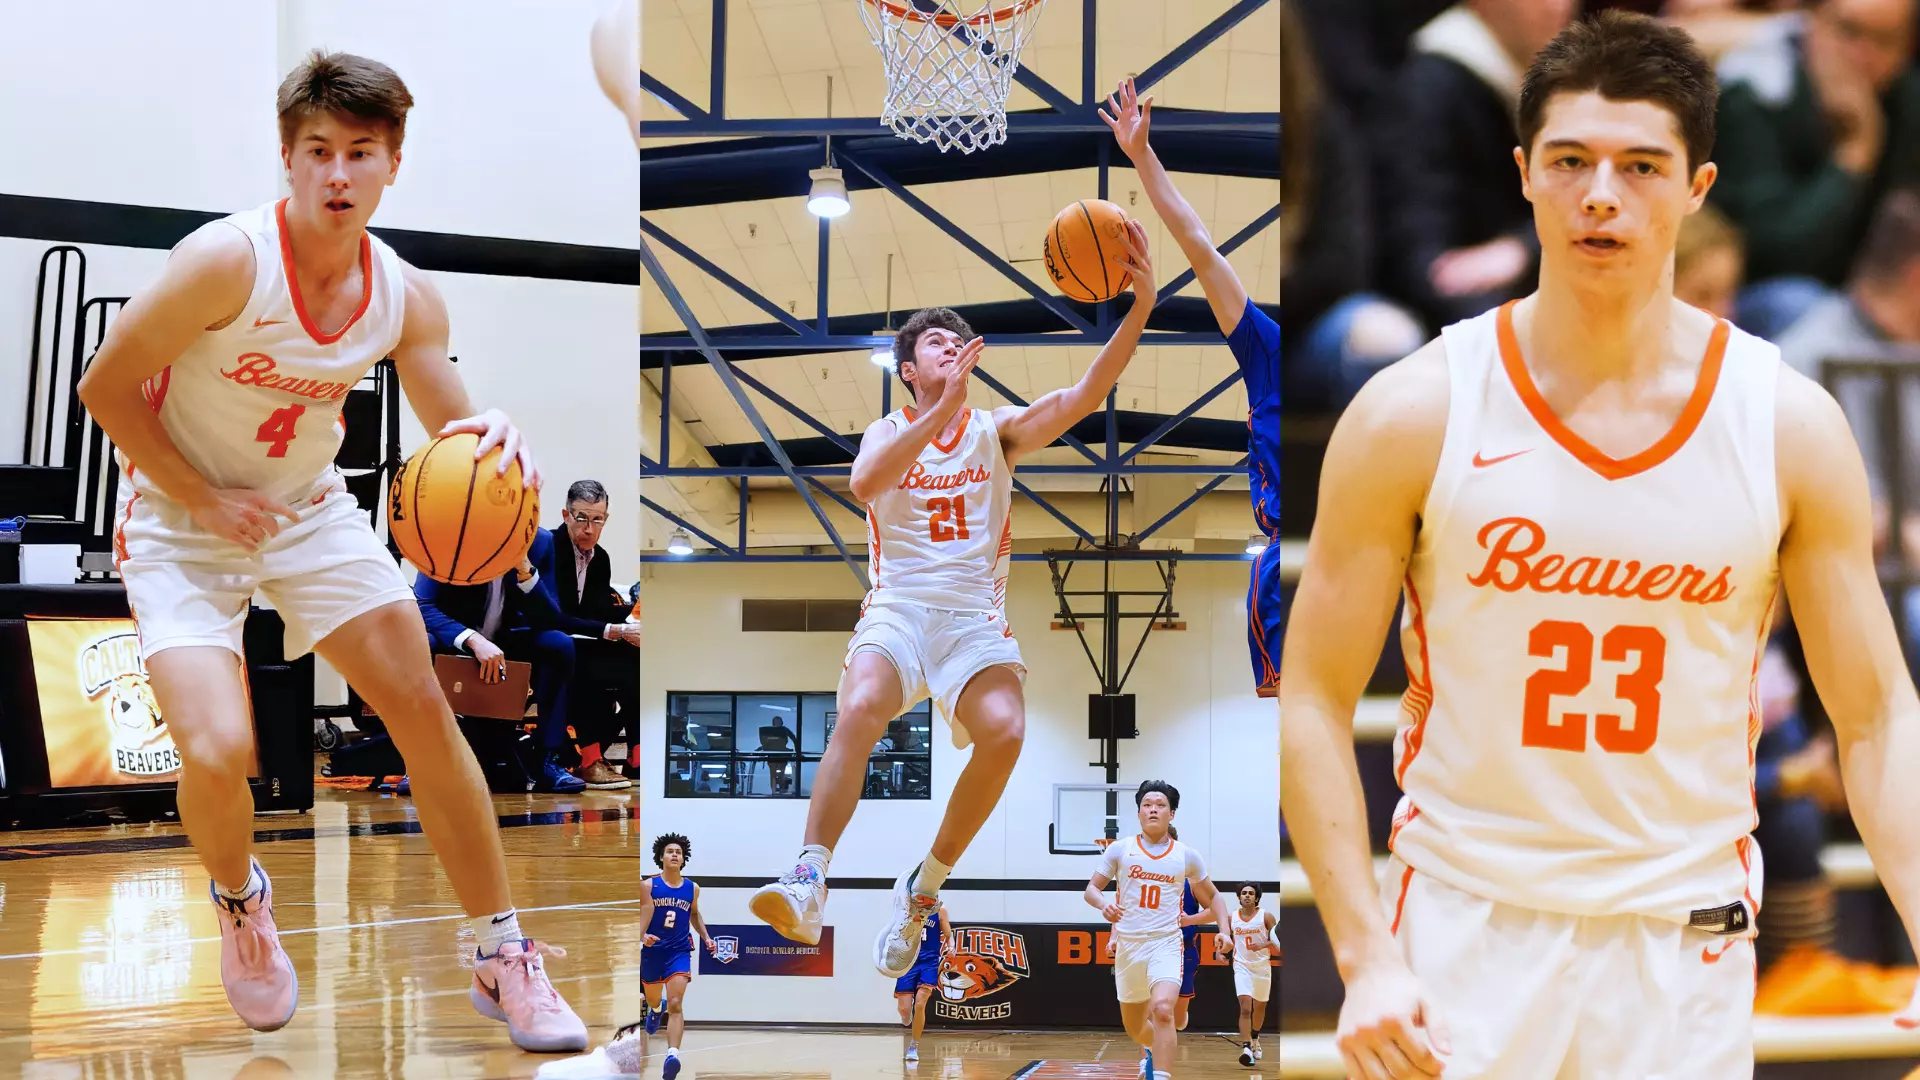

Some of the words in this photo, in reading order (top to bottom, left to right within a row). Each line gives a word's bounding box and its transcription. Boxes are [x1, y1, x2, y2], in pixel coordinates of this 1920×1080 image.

[220, 352, 353, 401] Beaver
[255, 403, 306, 458] 4
[898, 460, 991, 491] Beavers
[927, 494, 970, 543] 21
[1466, 516, 1737, 605] Beavers
[83, 638, 148, 688] CALT
[1521, 619, 1666, 754] 23
[117, 749, 181, 773] BEAVERS
[1128, 864, 1176, 884] Beavers
[1139, 883, 1161, 910] 10
[664, 910, 676, 928] 2
[1733, 910, 1743, 926] M
[936, 1001, 1012, 1021] BEAVERS
